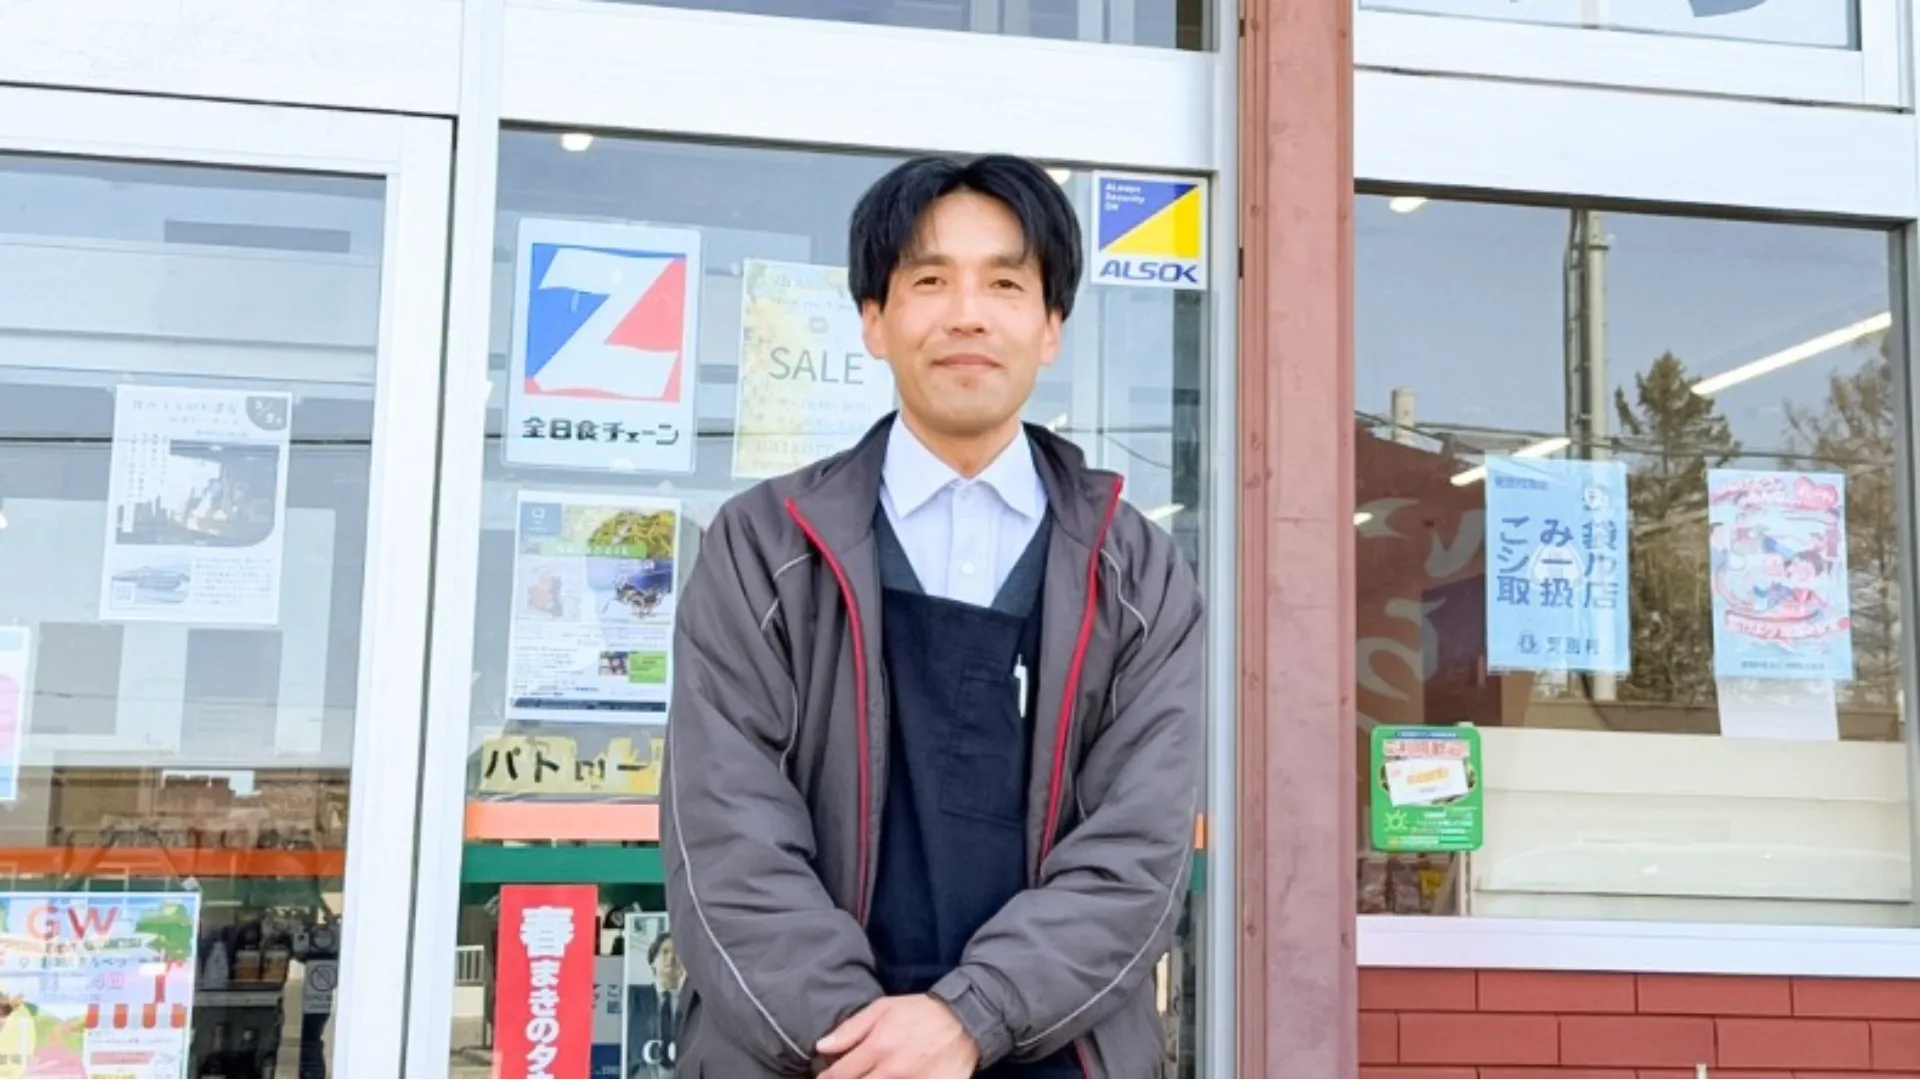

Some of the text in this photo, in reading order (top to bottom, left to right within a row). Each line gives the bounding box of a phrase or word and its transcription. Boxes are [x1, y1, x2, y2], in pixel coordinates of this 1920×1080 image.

[1100, 259, 1198, 283] ALSOK
[768, 346, 864, 385] SALE
[522, 416, 679, 445] 全日食チェーン
[26, 905, 119, 942] GW
